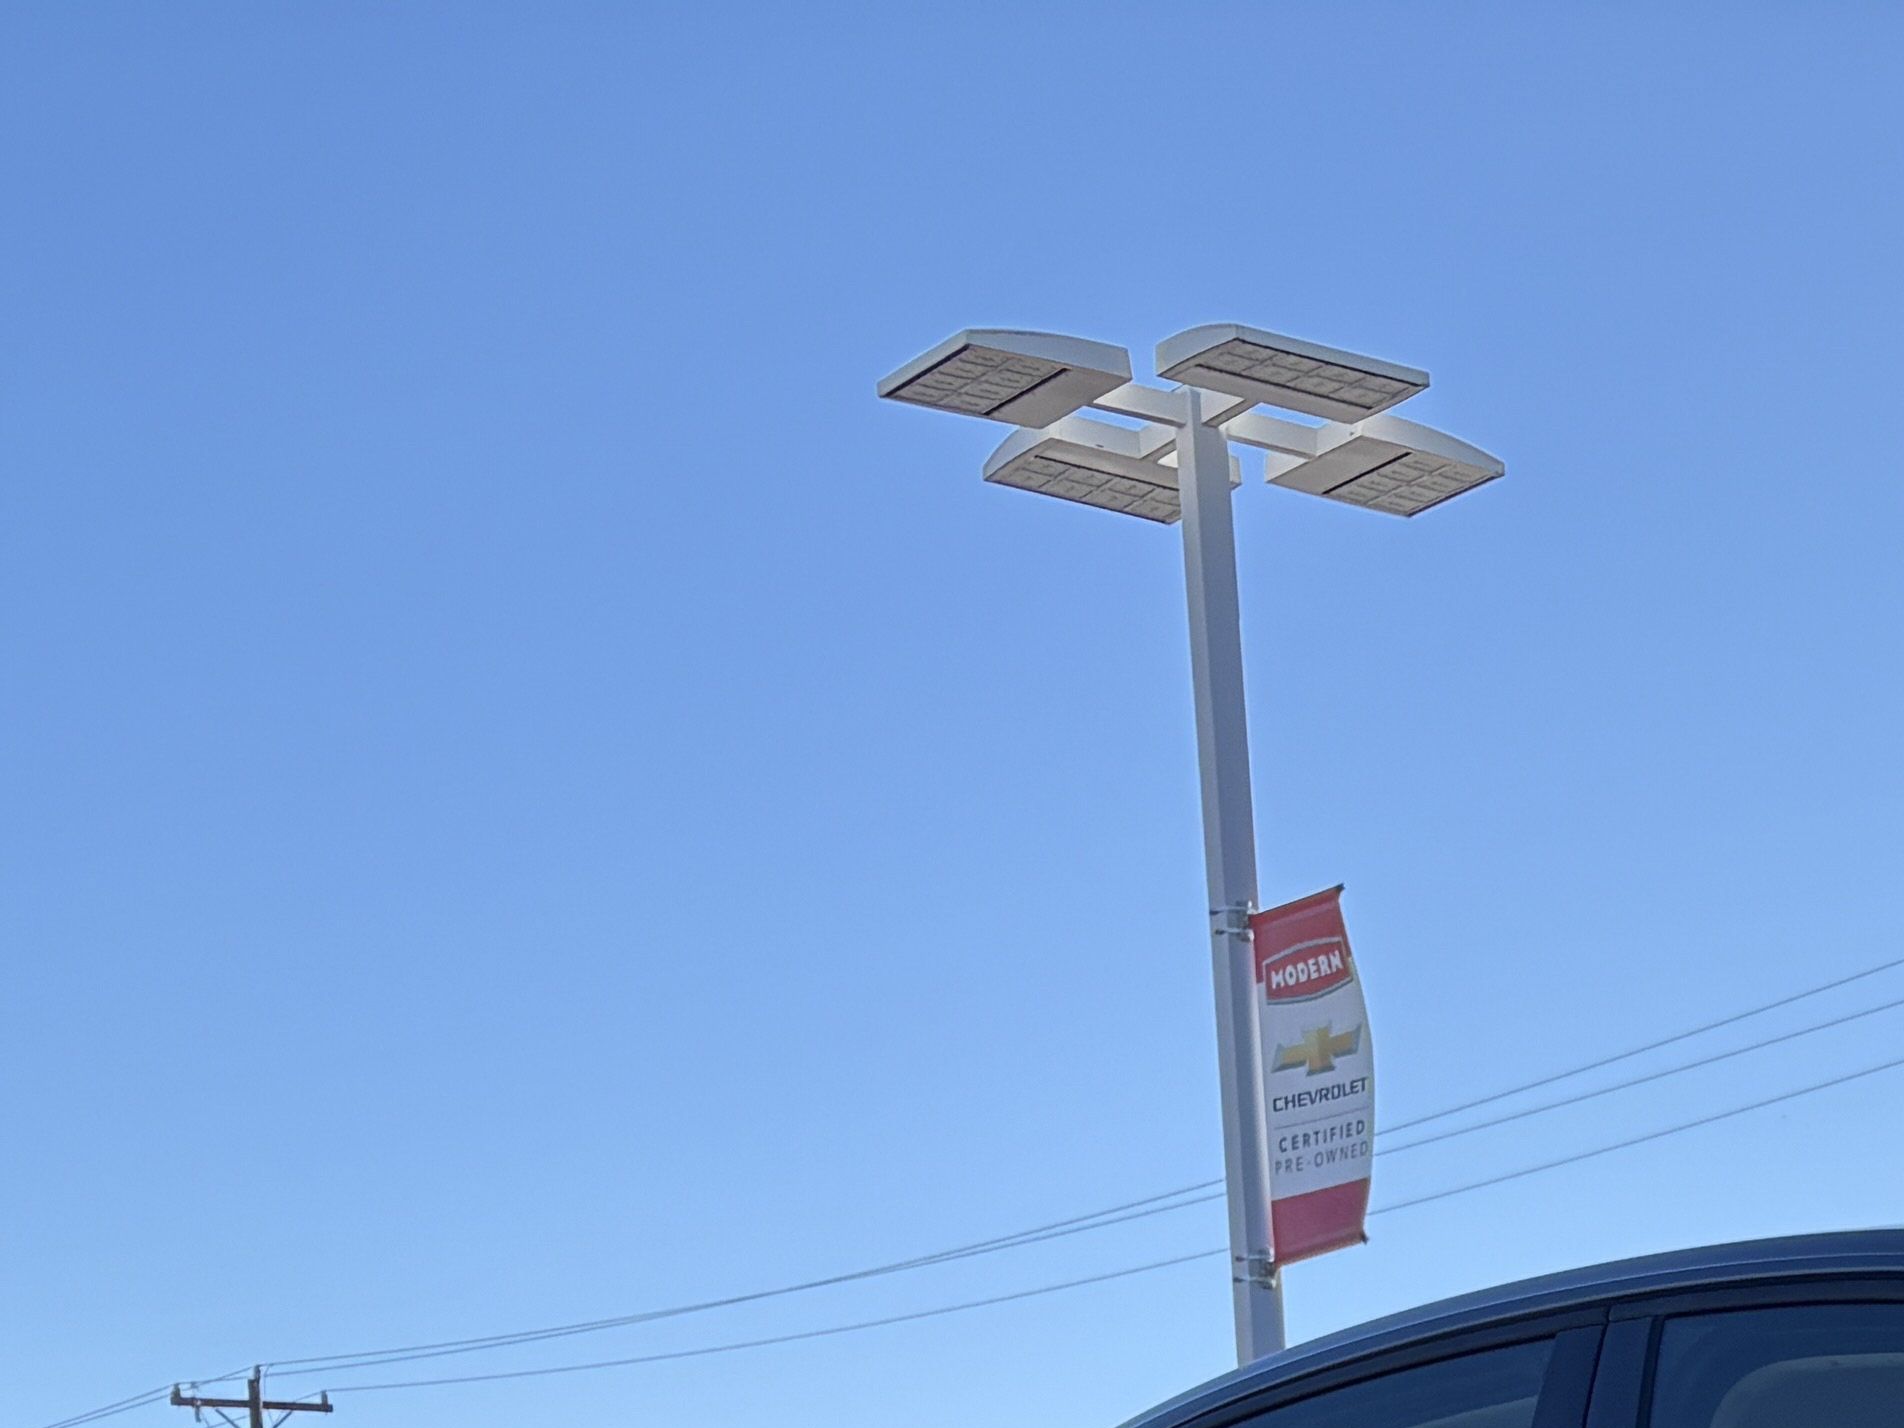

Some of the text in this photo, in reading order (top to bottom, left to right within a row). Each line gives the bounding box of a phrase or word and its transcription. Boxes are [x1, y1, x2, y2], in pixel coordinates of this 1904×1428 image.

[1270, 949, 1344, 990] MODERN
[1272, 1076, 1370, 1113] CHEVROLET
[1278, 1119, 1366, 1153] CERTIFIED
[1274, 1142, 1370, 1175] PRE-OWNED
